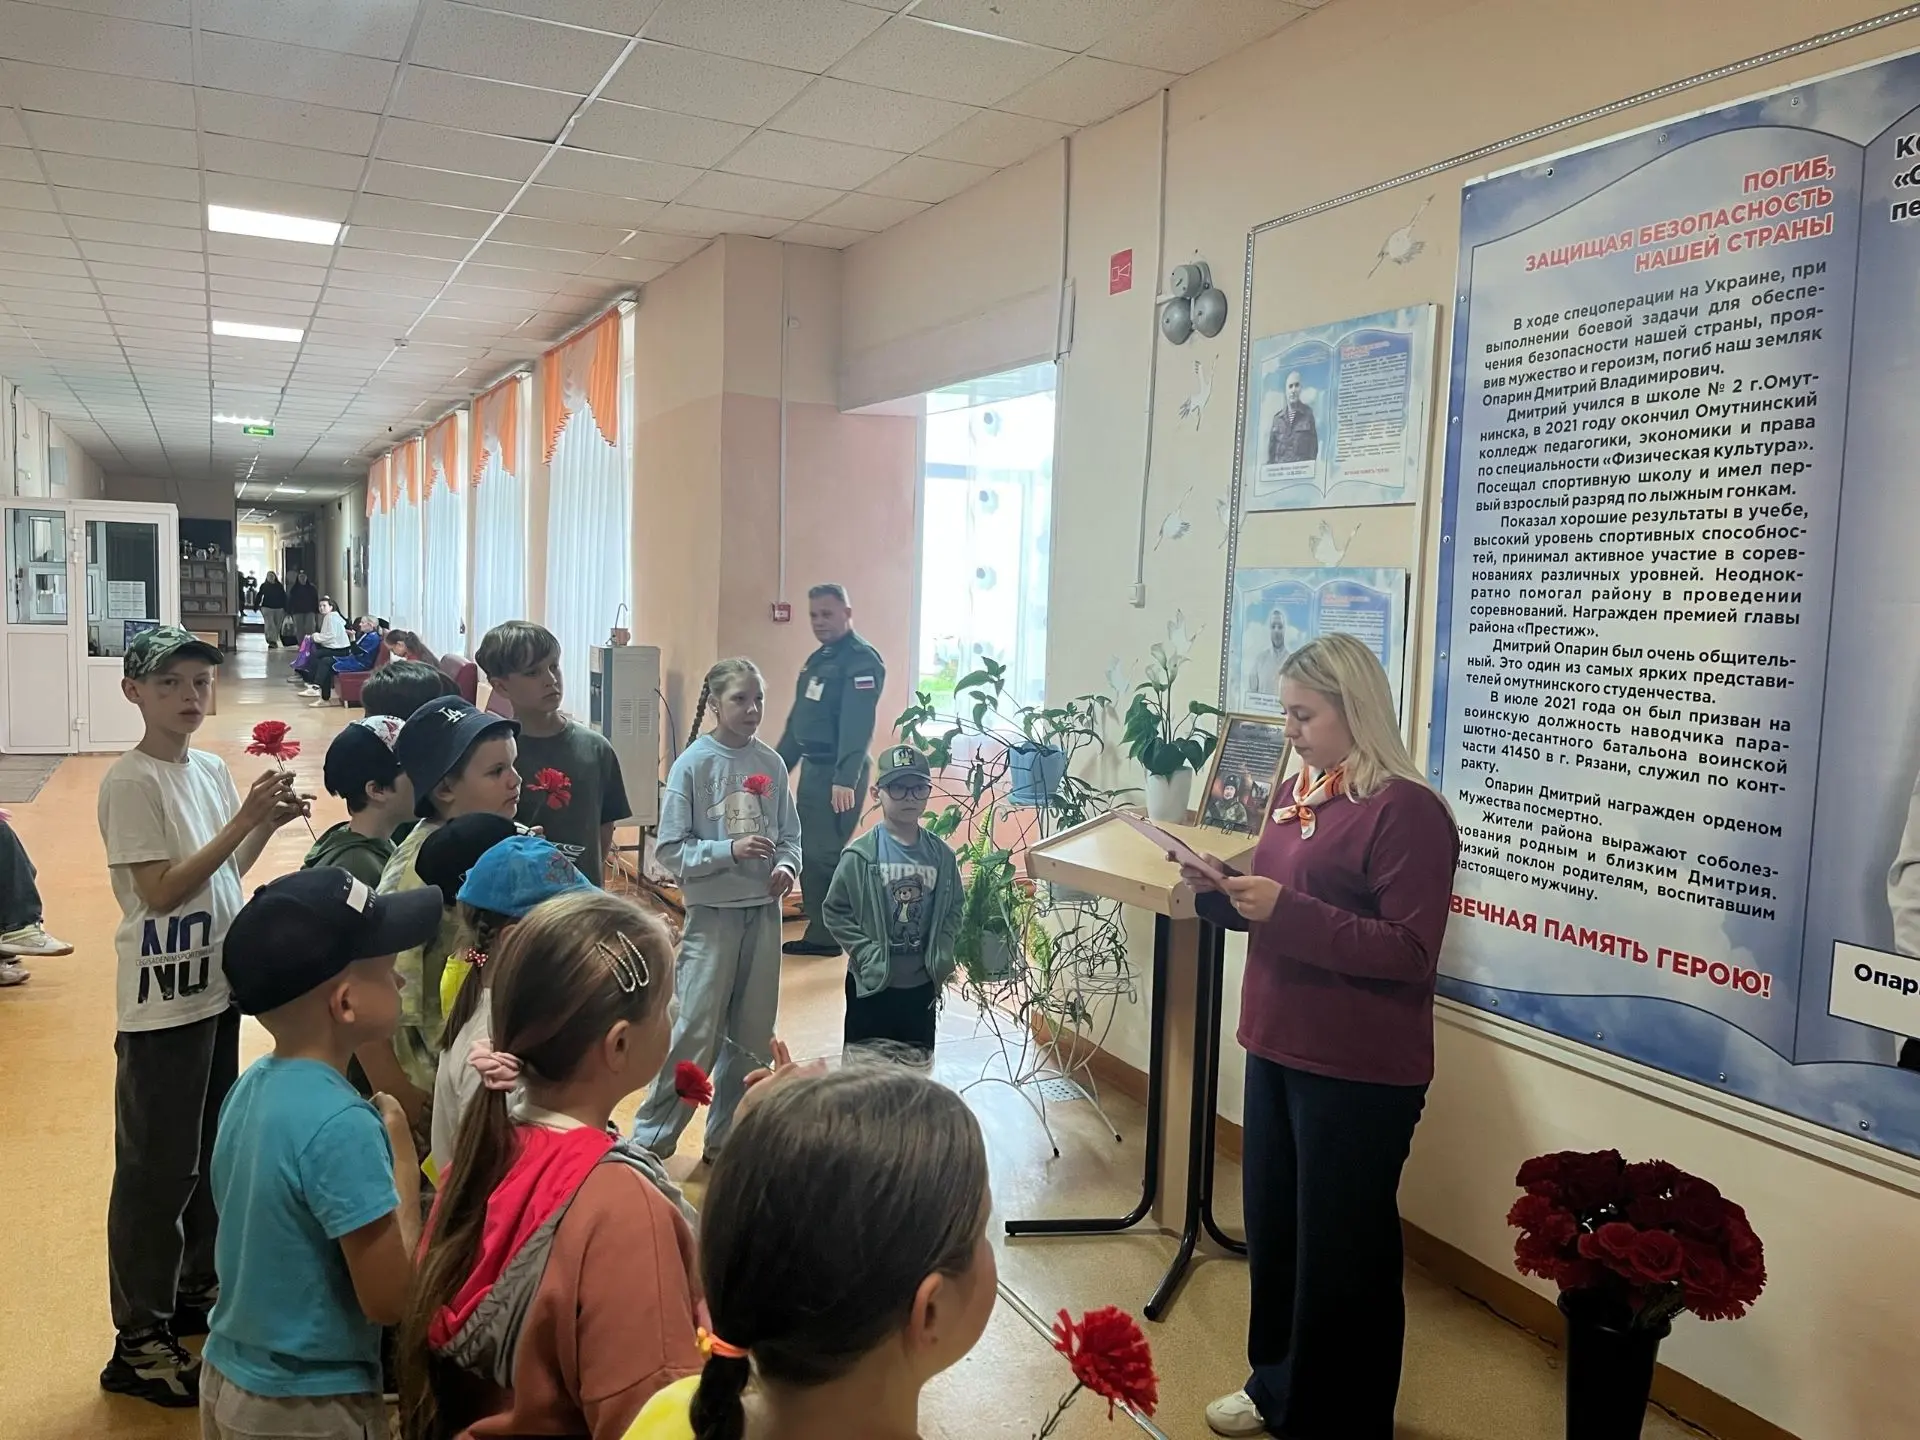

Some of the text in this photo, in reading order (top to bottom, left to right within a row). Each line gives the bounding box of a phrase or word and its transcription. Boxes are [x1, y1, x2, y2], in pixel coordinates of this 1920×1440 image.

[1745, 158, 1835, 192] ПОГИБ,
[1525, 187, 1832, 272] ЗАЩИЩАЯ БЕЗОПАСНОСТЬ
[1636, 216, 1833, 272] НАШЕЙ СТРАНЫ
[1513, 261, 1826, 331] В ходе спецоперации на Украине, при
[1485, 307, 1823, 371] чения безопасности нашей страны, проя-
[1486, 285, 1824, 354] выполнении боевой задачи для обеспе-
[1483, 328, 1822, 389] вив мужество и героизм, погиб наш земляк
[1482, 363, 1724, 407] Опарин Дмитрий Владимирович.
[1506, 401, 1567, 423] Дмитрий
[1572, 396, 1625, 416] учился
[1631, 394, 1640, 406] в
[1646, 387, 1701, 404] школе
[1732, 378, 1743, 393] 2
[1480, 390, 1817, 442] нинска, в 2021 году окончил Омутнинский
[1479, 417, 1815, 459] колледж педагогики, экономики и права
[1476, 484, 1796, 512] вый взрослый разряд по лыжным гонкам.
[1477, 461, 1812, 494] Посещал спортивную школу и имел пер-
[1473, 524, 1807, 547] высокий уровень спортивных способнос-
[1500, 502, 1808, 528] Показал хорошие результаты в учебе,
[1472, 548, 1805, 566] тей, принимал активное участие в сорев-
[1472, 566, 1803, 584] нованиях различных уровней. Неоднок-
[1470, 603, 1800, 625] соревнований. Награжден премией главы
[1471, 585, 1802, 605] ратно помогал району в проведении
[1469, 620, 1599, 638] района «Престиж».
[1467, 655, 1795, 689] ный. Это один из самых ярких представи-
[1492, 638, 1796, 667] Дмитрий Опарин был очень общитель-
[1466, 672, 1716, 704] телей омутнинского студенчества.
[1464, 707, 1789, 753] воинскую должность наводчика пара-
[1490, 690, 1791, 732] В июле 2021 года он был призван на
[1461, 758, 1499, 774] ракту.
[1462, 741, 1496, 755] части
[1501, 744, 1541, 761] 41450
[1546, 752, 1554, 763] в
[1575, 753, 1631, 776] Рязани,
[1638, 765, 1700, 783] служил
[1707, 774, 1729, 787] по
[1736, 778, 1786, 794] конт-
[1463, 724, 1787, 774] шютно-десантного батальона воинской
[1459, 789, 1602, 826] Мужества посмертно.
[1484, 776, 1782, 837] Опарин Дмитрий награжден орденом
[1481, 810, 1779, 878] Жители района выражают соболез-
[1449, 894, 1772, 998] ВЕЧНАЯ ПАМЯТЬ ГЕРОЮ!
